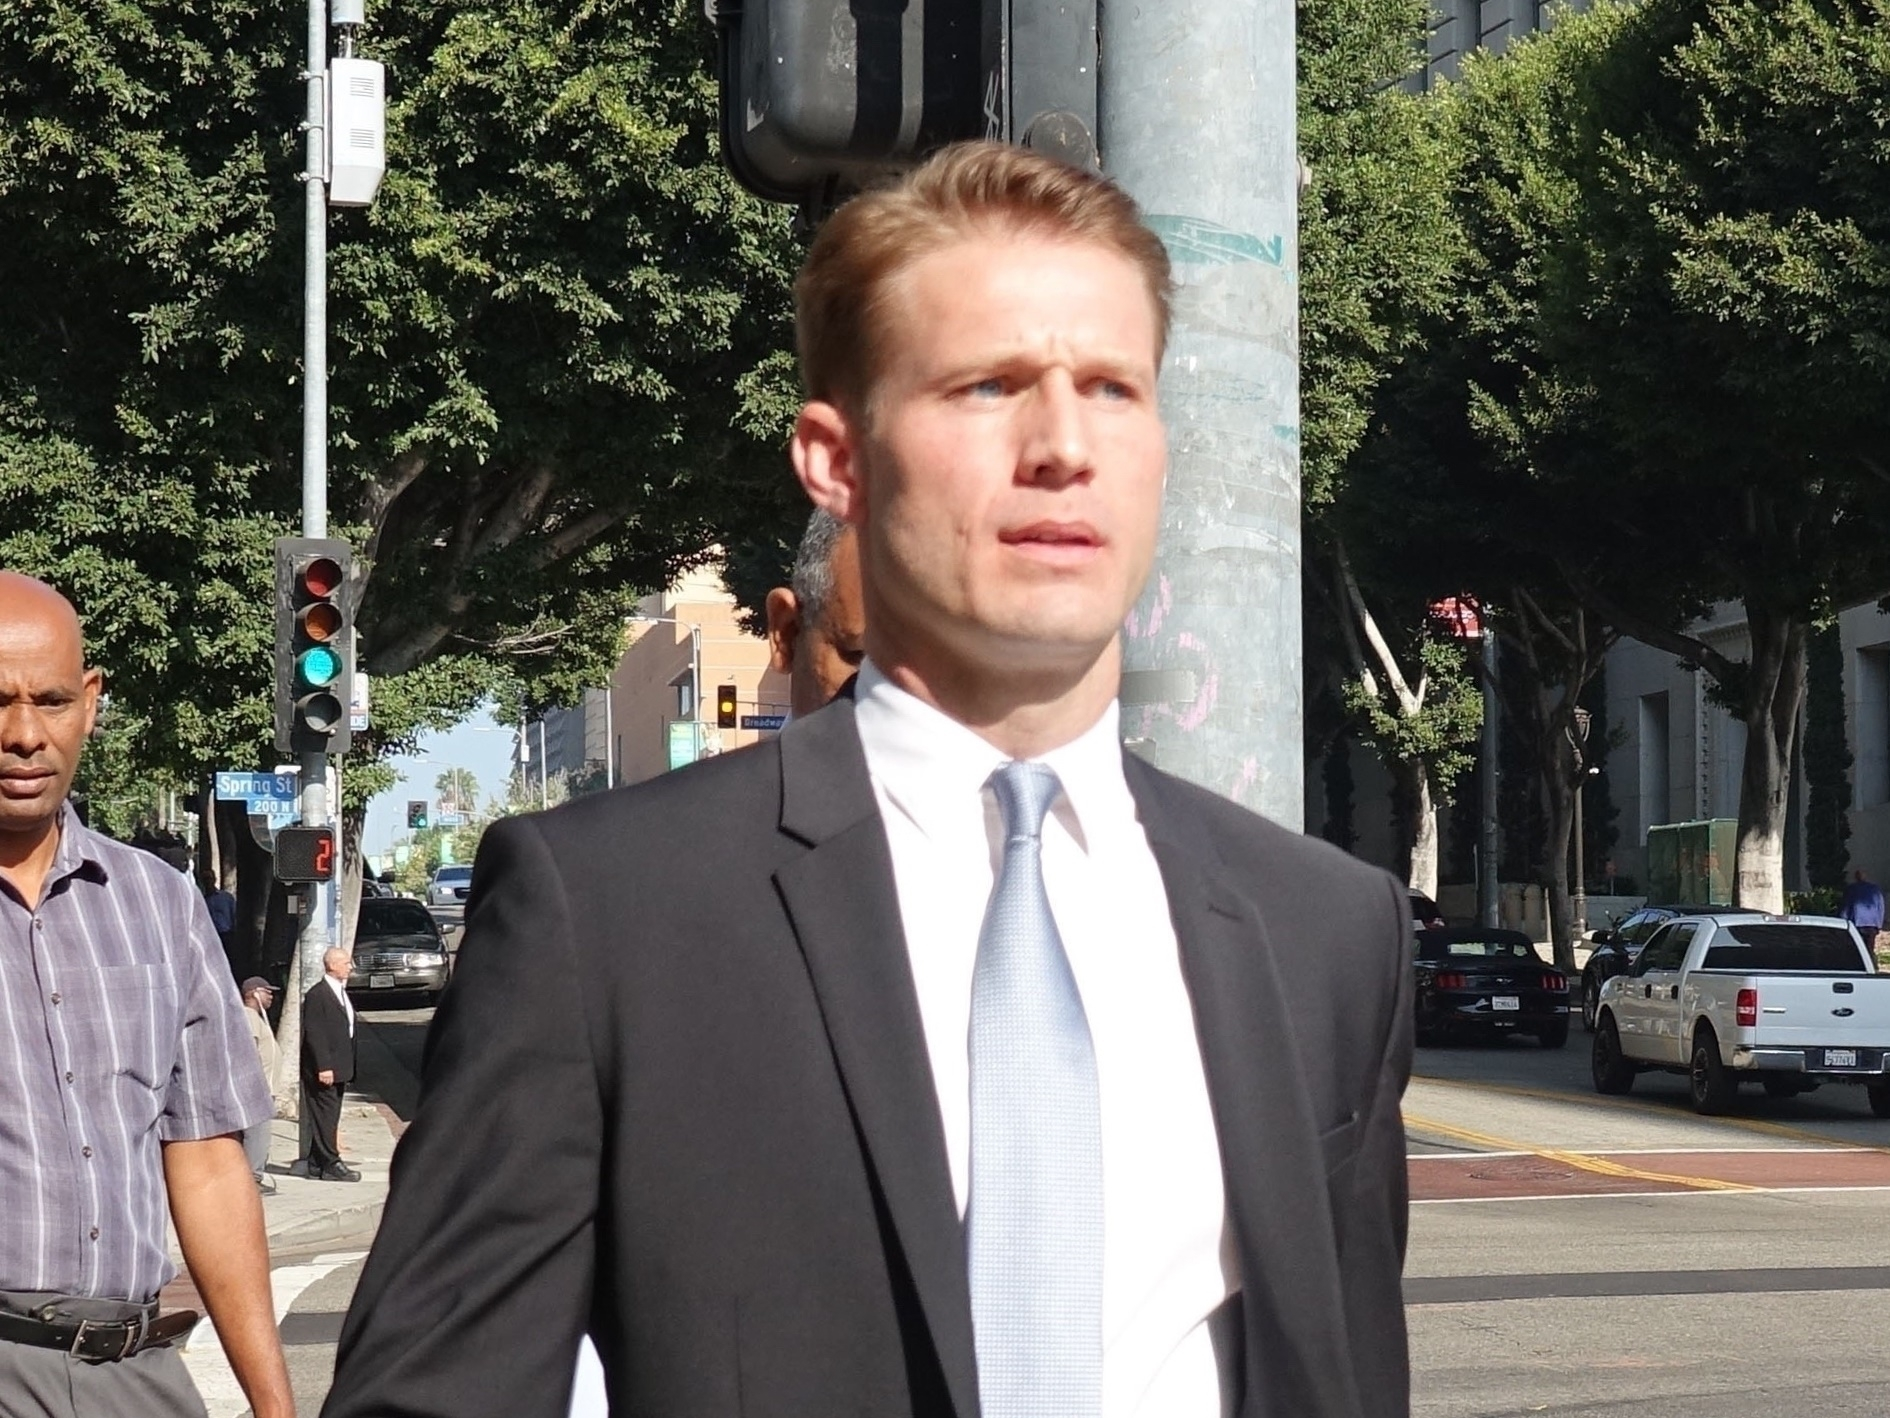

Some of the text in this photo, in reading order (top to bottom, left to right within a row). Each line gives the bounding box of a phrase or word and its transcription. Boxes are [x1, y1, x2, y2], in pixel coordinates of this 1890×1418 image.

[220, 775, 293, 798] Spring St
[254, 800, 290, 813] 200 N
[316, 839, 330, 871] 2
